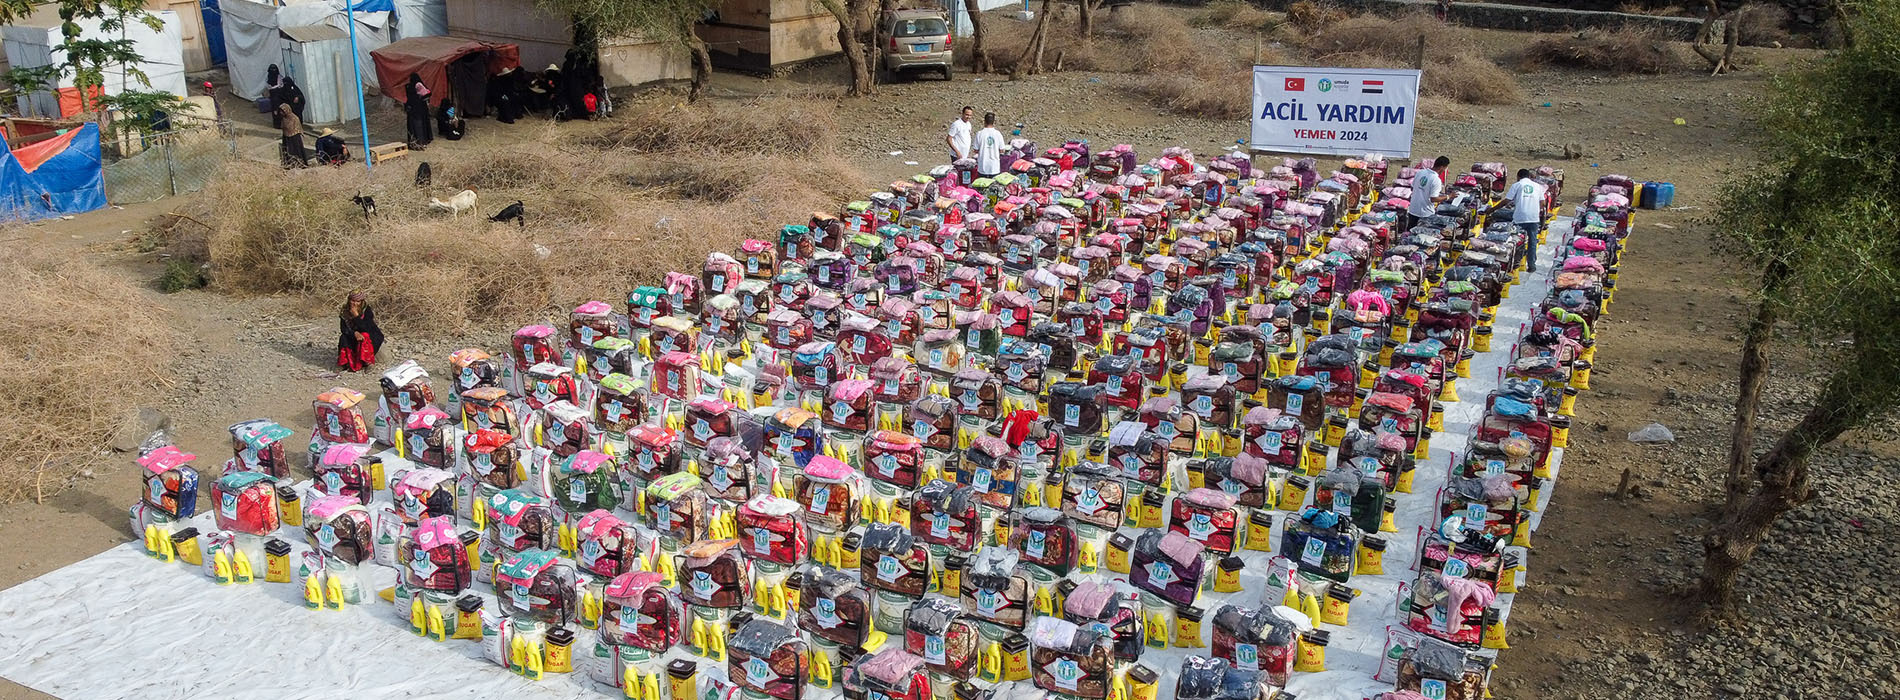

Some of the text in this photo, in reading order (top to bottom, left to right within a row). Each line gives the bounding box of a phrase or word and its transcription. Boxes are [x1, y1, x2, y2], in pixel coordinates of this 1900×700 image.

[1261, 98, 1406, 125] ACİL YARDIM
[1293, 129, 1368, 141] YEMEN 2024
